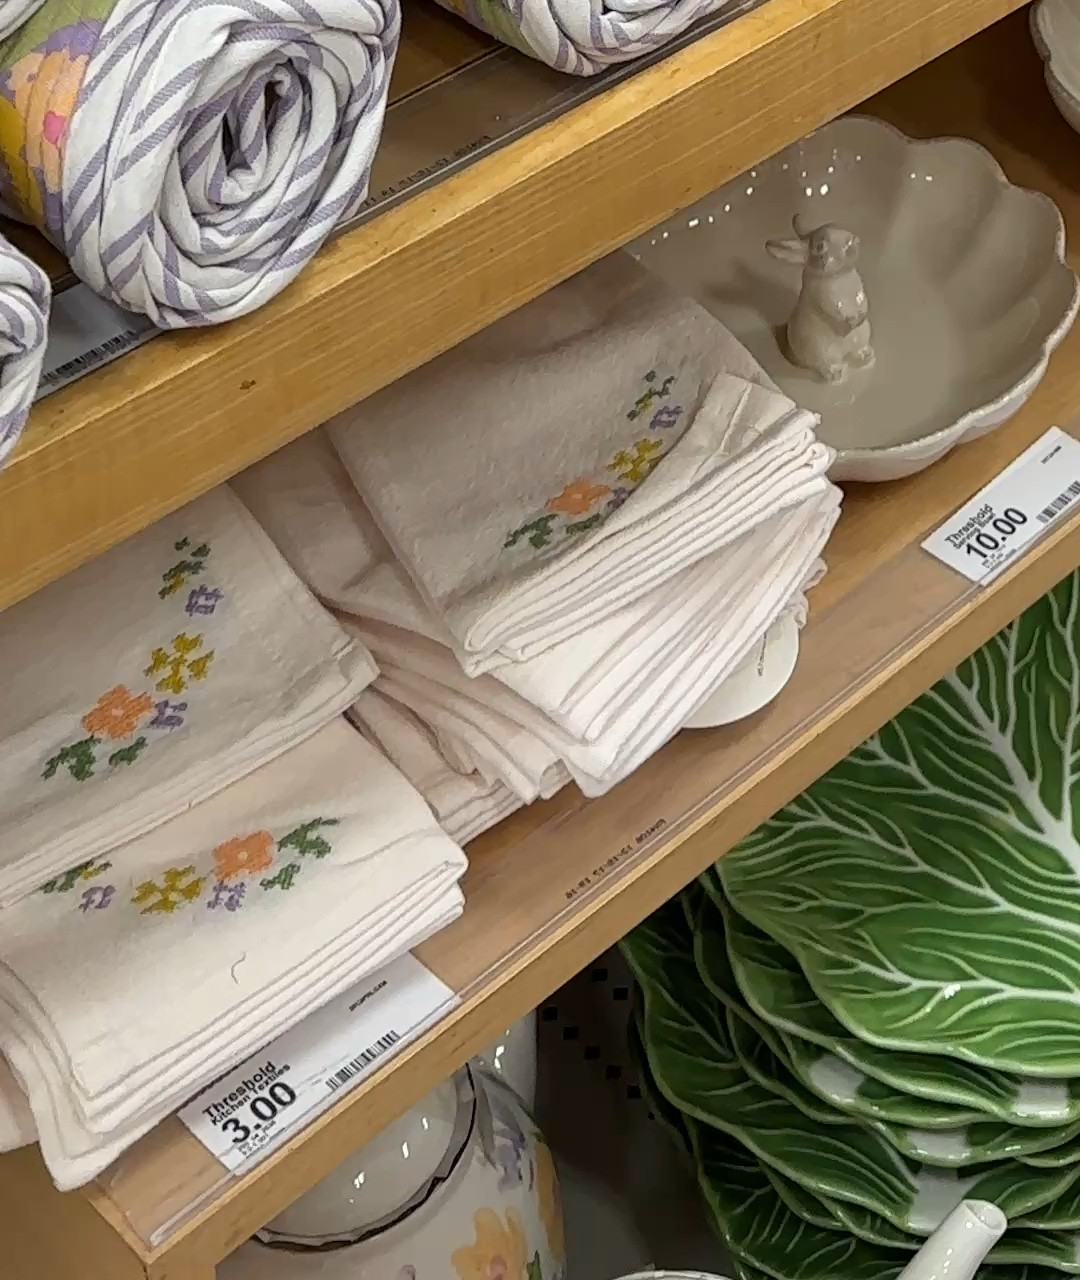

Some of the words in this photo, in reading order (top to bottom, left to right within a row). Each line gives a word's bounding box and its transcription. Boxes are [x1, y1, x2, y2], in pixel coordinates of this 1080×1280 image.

[944, 503, 994, 546] Threshold
[966, 507, 1028, 559] 10.00
[202, 1060, 277, 1121] Threshold
[209, 1092, 252, 1127] Kitchen
[248, 1063, 292, 1098] Textiles
[221, 1080, 298, 1145] 3.00
